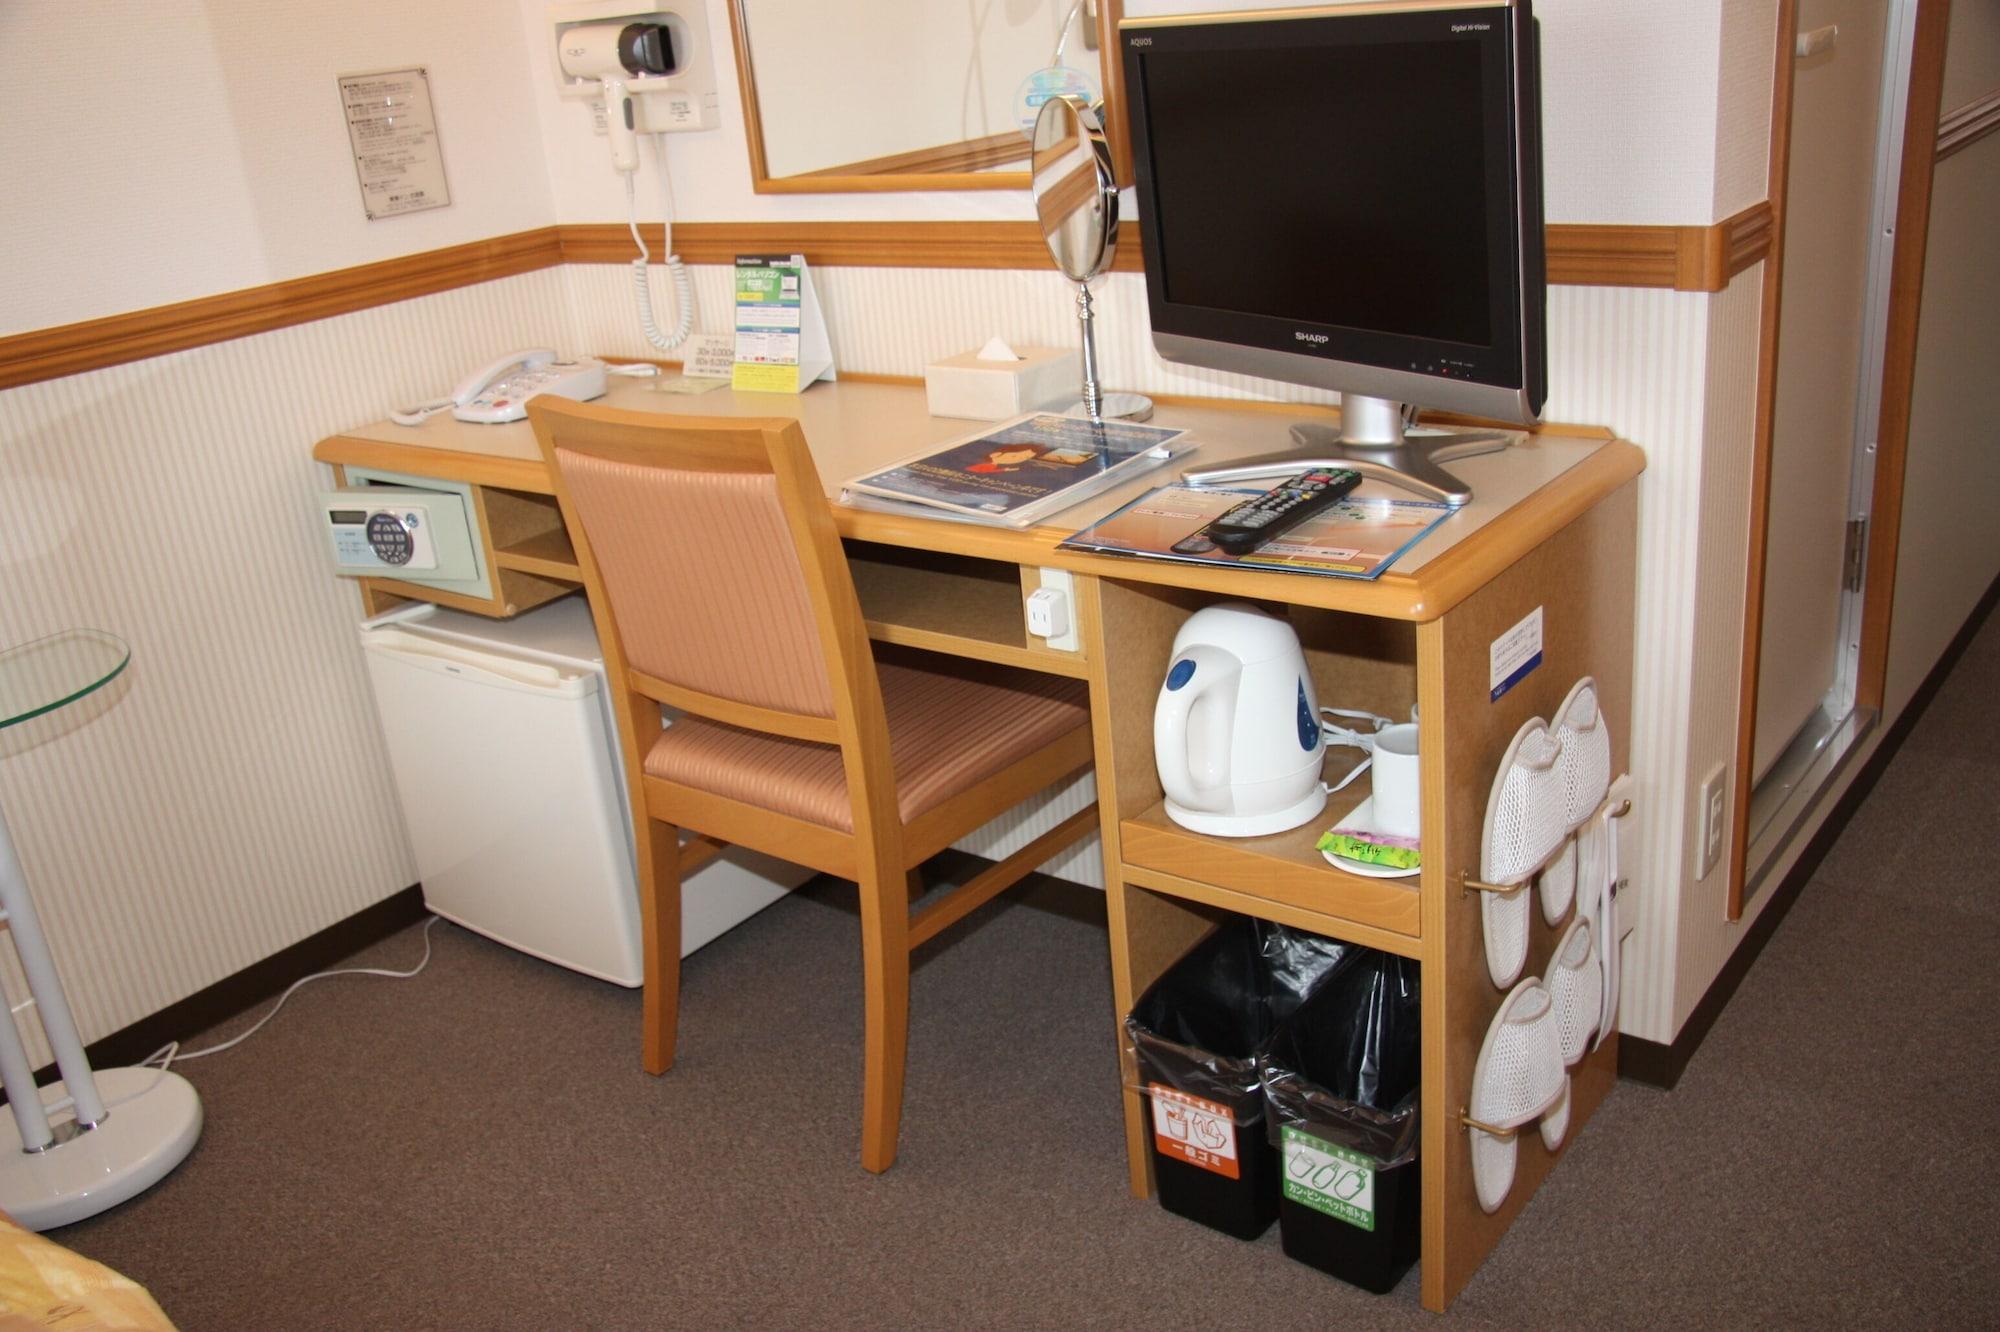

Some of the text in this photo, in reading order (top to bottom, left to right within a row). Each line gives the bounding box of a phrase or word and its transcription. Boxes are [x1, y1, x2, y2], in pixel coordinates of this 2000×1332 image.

[1130, 37, 1152, 47] AQUOS
[1295, 332, 1329, 344] SHARP
[1172, 1143, 1221, 1167] 一般ゴミ
[1288, 1183, 1369, 1223] カン・ビン・ペットボトル
